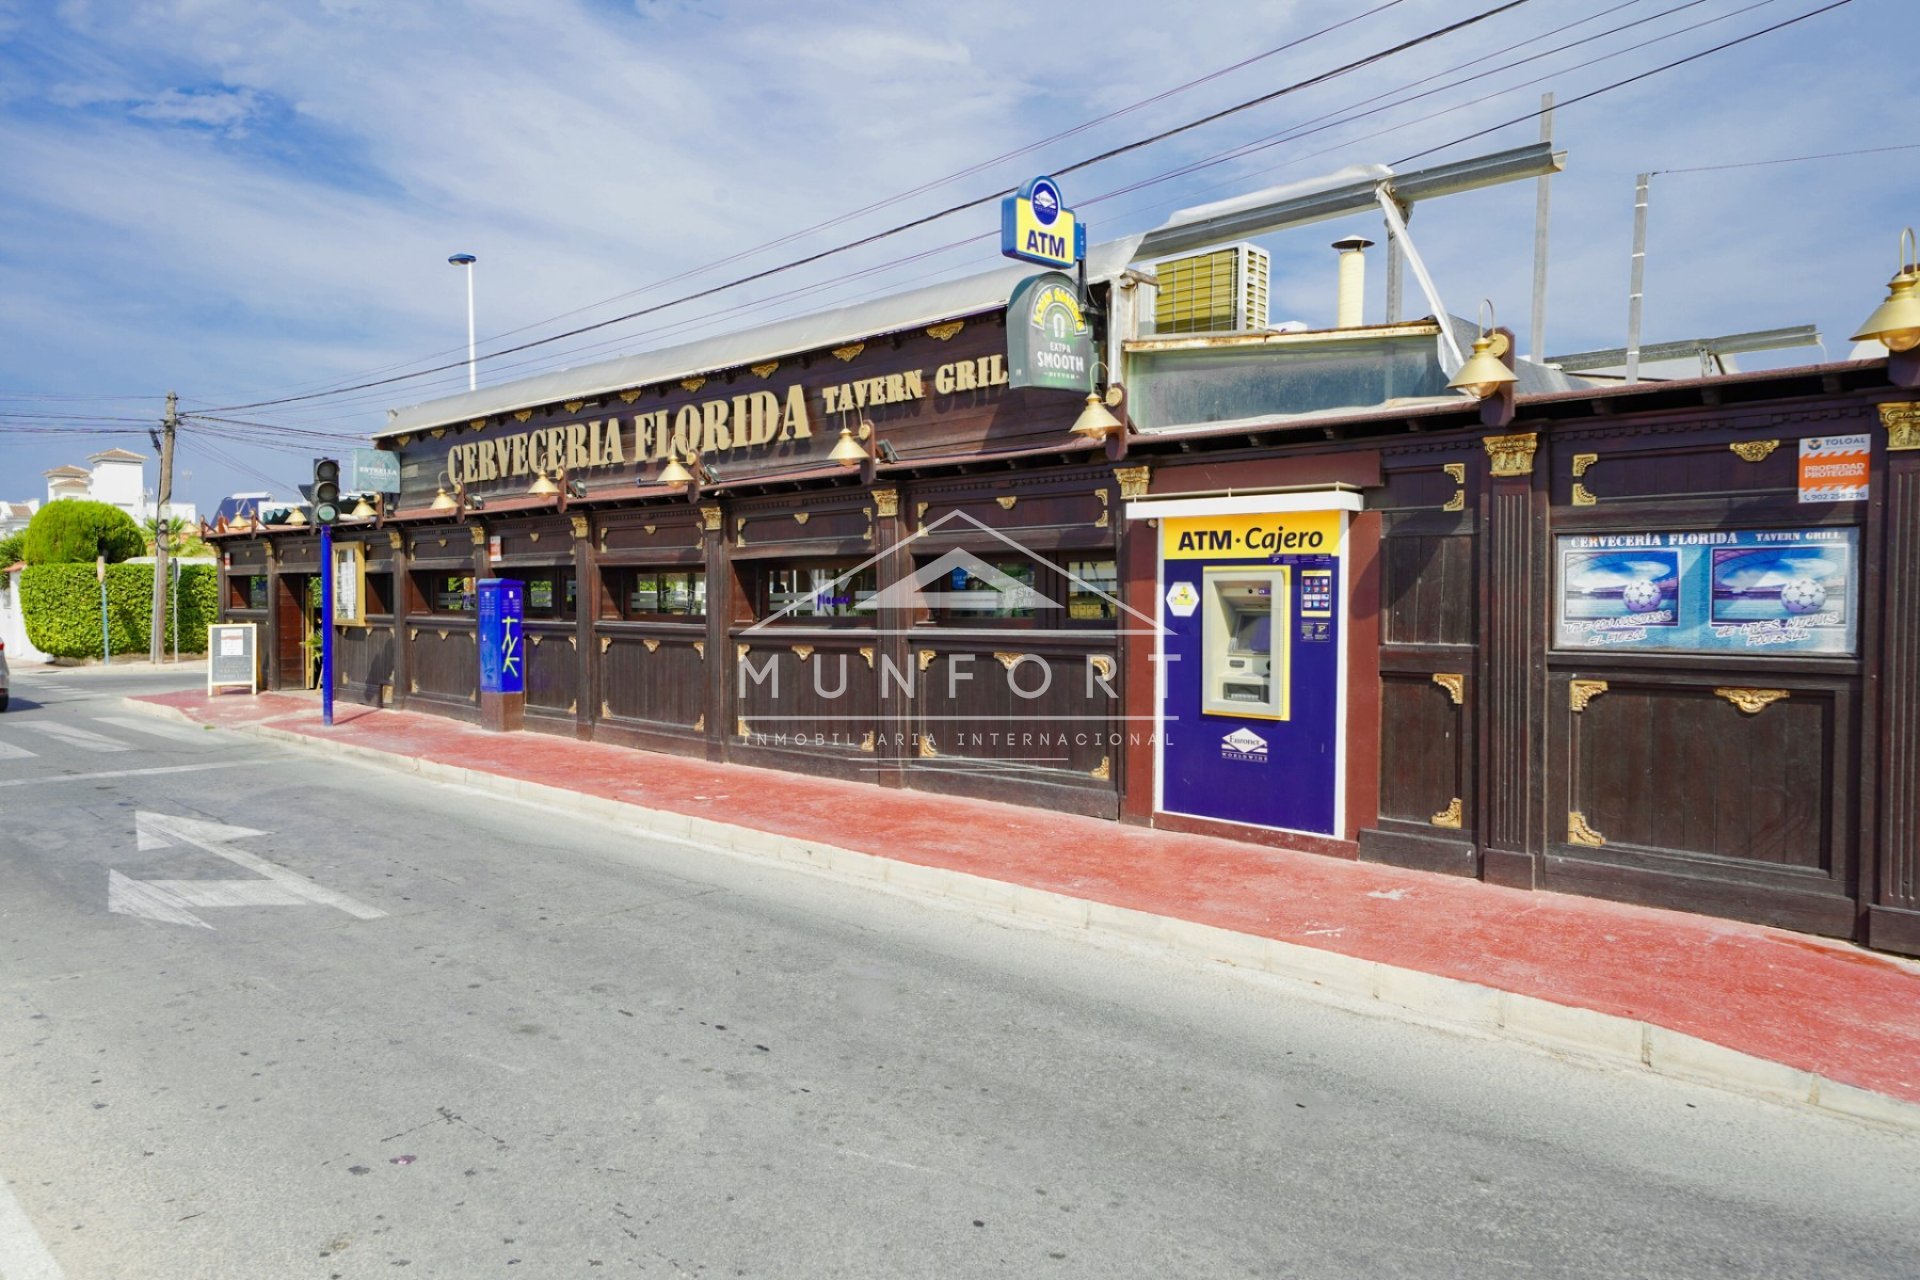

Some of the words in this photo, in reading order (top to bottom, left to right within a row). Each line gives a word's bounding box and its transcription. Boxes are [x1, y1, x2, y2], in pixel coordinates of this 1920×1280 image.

[1027, 229, 1065, 258] ATM
[1049, 341, 1072, 353] EXTRA
[1037, 351, 1084, 372] SMOOTH
[448, 418, 625, 484] CERVECERIA
[634, 384, 812, 462] FLORIDA
[822, 369, 926, 414] TAVERN
[935, 354, 1009, 395] GRIL
[1804, 462, 1865, 472] PROPIEDAD
[1804, 469, 1864, 478] PROTEGIDA
[1178, 530, 1232, 551] ATM
[1245, 526, 1323, 553] Cajero
[1571, 532, 1661, 548] CERVECERÍA
[1668, 533, 1738, 546] FLORIDA
[1755, 533, 1800, 541] TAVERN
[1805, 531, 1841, 540] GRILL
